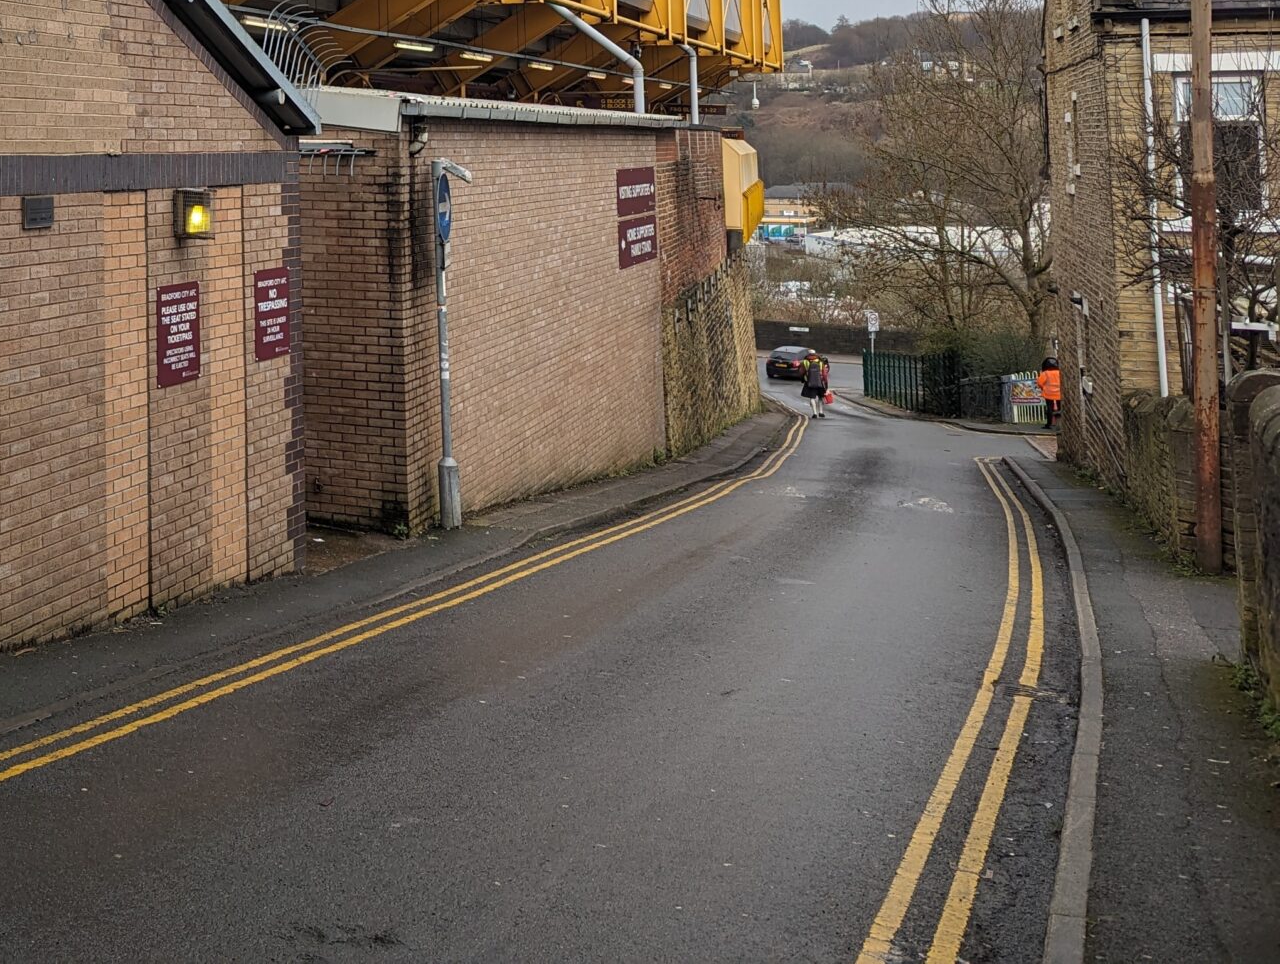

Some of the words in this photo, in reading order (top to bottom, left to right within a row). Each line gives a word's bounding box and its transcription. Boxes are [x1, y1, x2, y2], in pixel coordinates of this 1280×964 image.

[633, 183, 650, 197] SUPPORTERS
[637, 224, 654, 239] SUPPORTERS
[258, 280, 274, 288] BRADFORD
[161, 292, 181, 301] BRADFORD
[269, 288, 277, 299] NO
[162, 305, 177, 315] PLEASE
[178, 304, 186, 312] USE
[187, 301, 197, 310] ONLY
[258, 298, 287, 312] TRESPASSING
[161, 316, 170, 324] THE
[171, 314, 181, 324] SEAT
[182, 311, 196, 321] STATED
[277, 316, 286, 324] UNDER
[170, 325, 178, 333] ON
[178, 323, 190, 332] YOUR
[271, 325, 280, 333] HOUR
